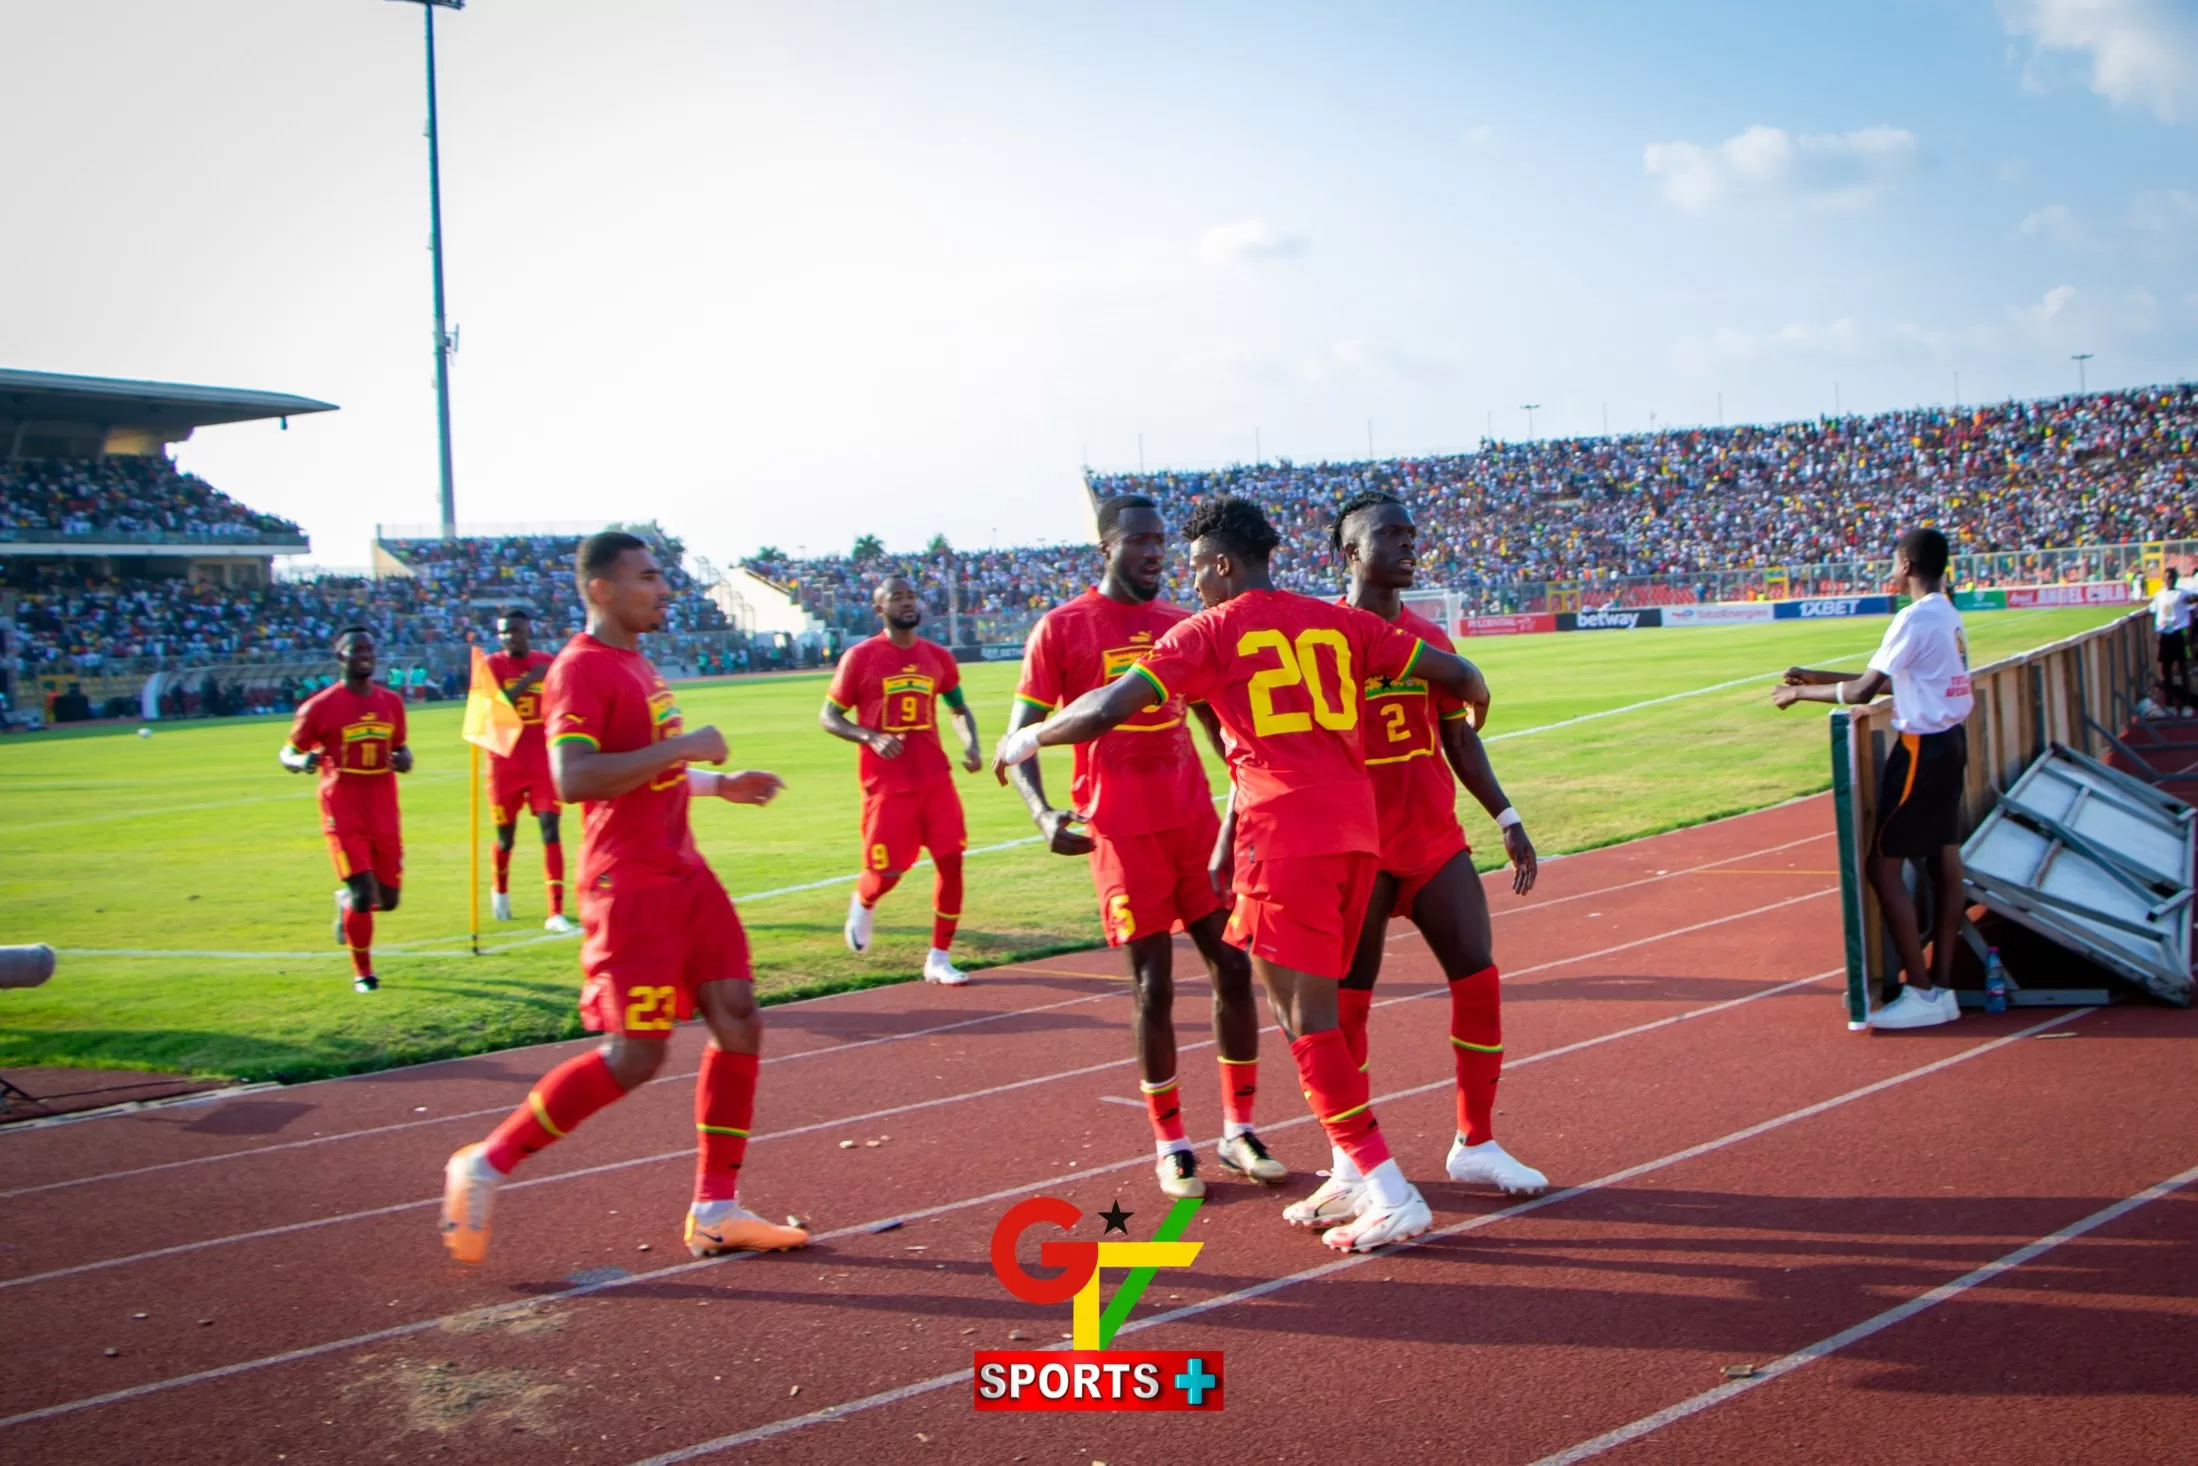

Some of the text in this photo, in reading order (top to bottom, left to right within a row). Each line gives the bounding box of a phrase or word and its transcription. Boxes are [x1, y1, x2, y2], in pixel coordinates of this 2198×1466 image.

[1576, 613, 1639, 628] betway
[1800, 600, 1859, 616] 1XBET
[1236, 628, 1358, 737] 20
[901, 696, 917, 722] 9
[1380, 703, 1411, 743] 2
[871, 844, 889, 870] 9
[1110, 895, 1136, 942] 5
[625, 985, 676, 1030] 23
